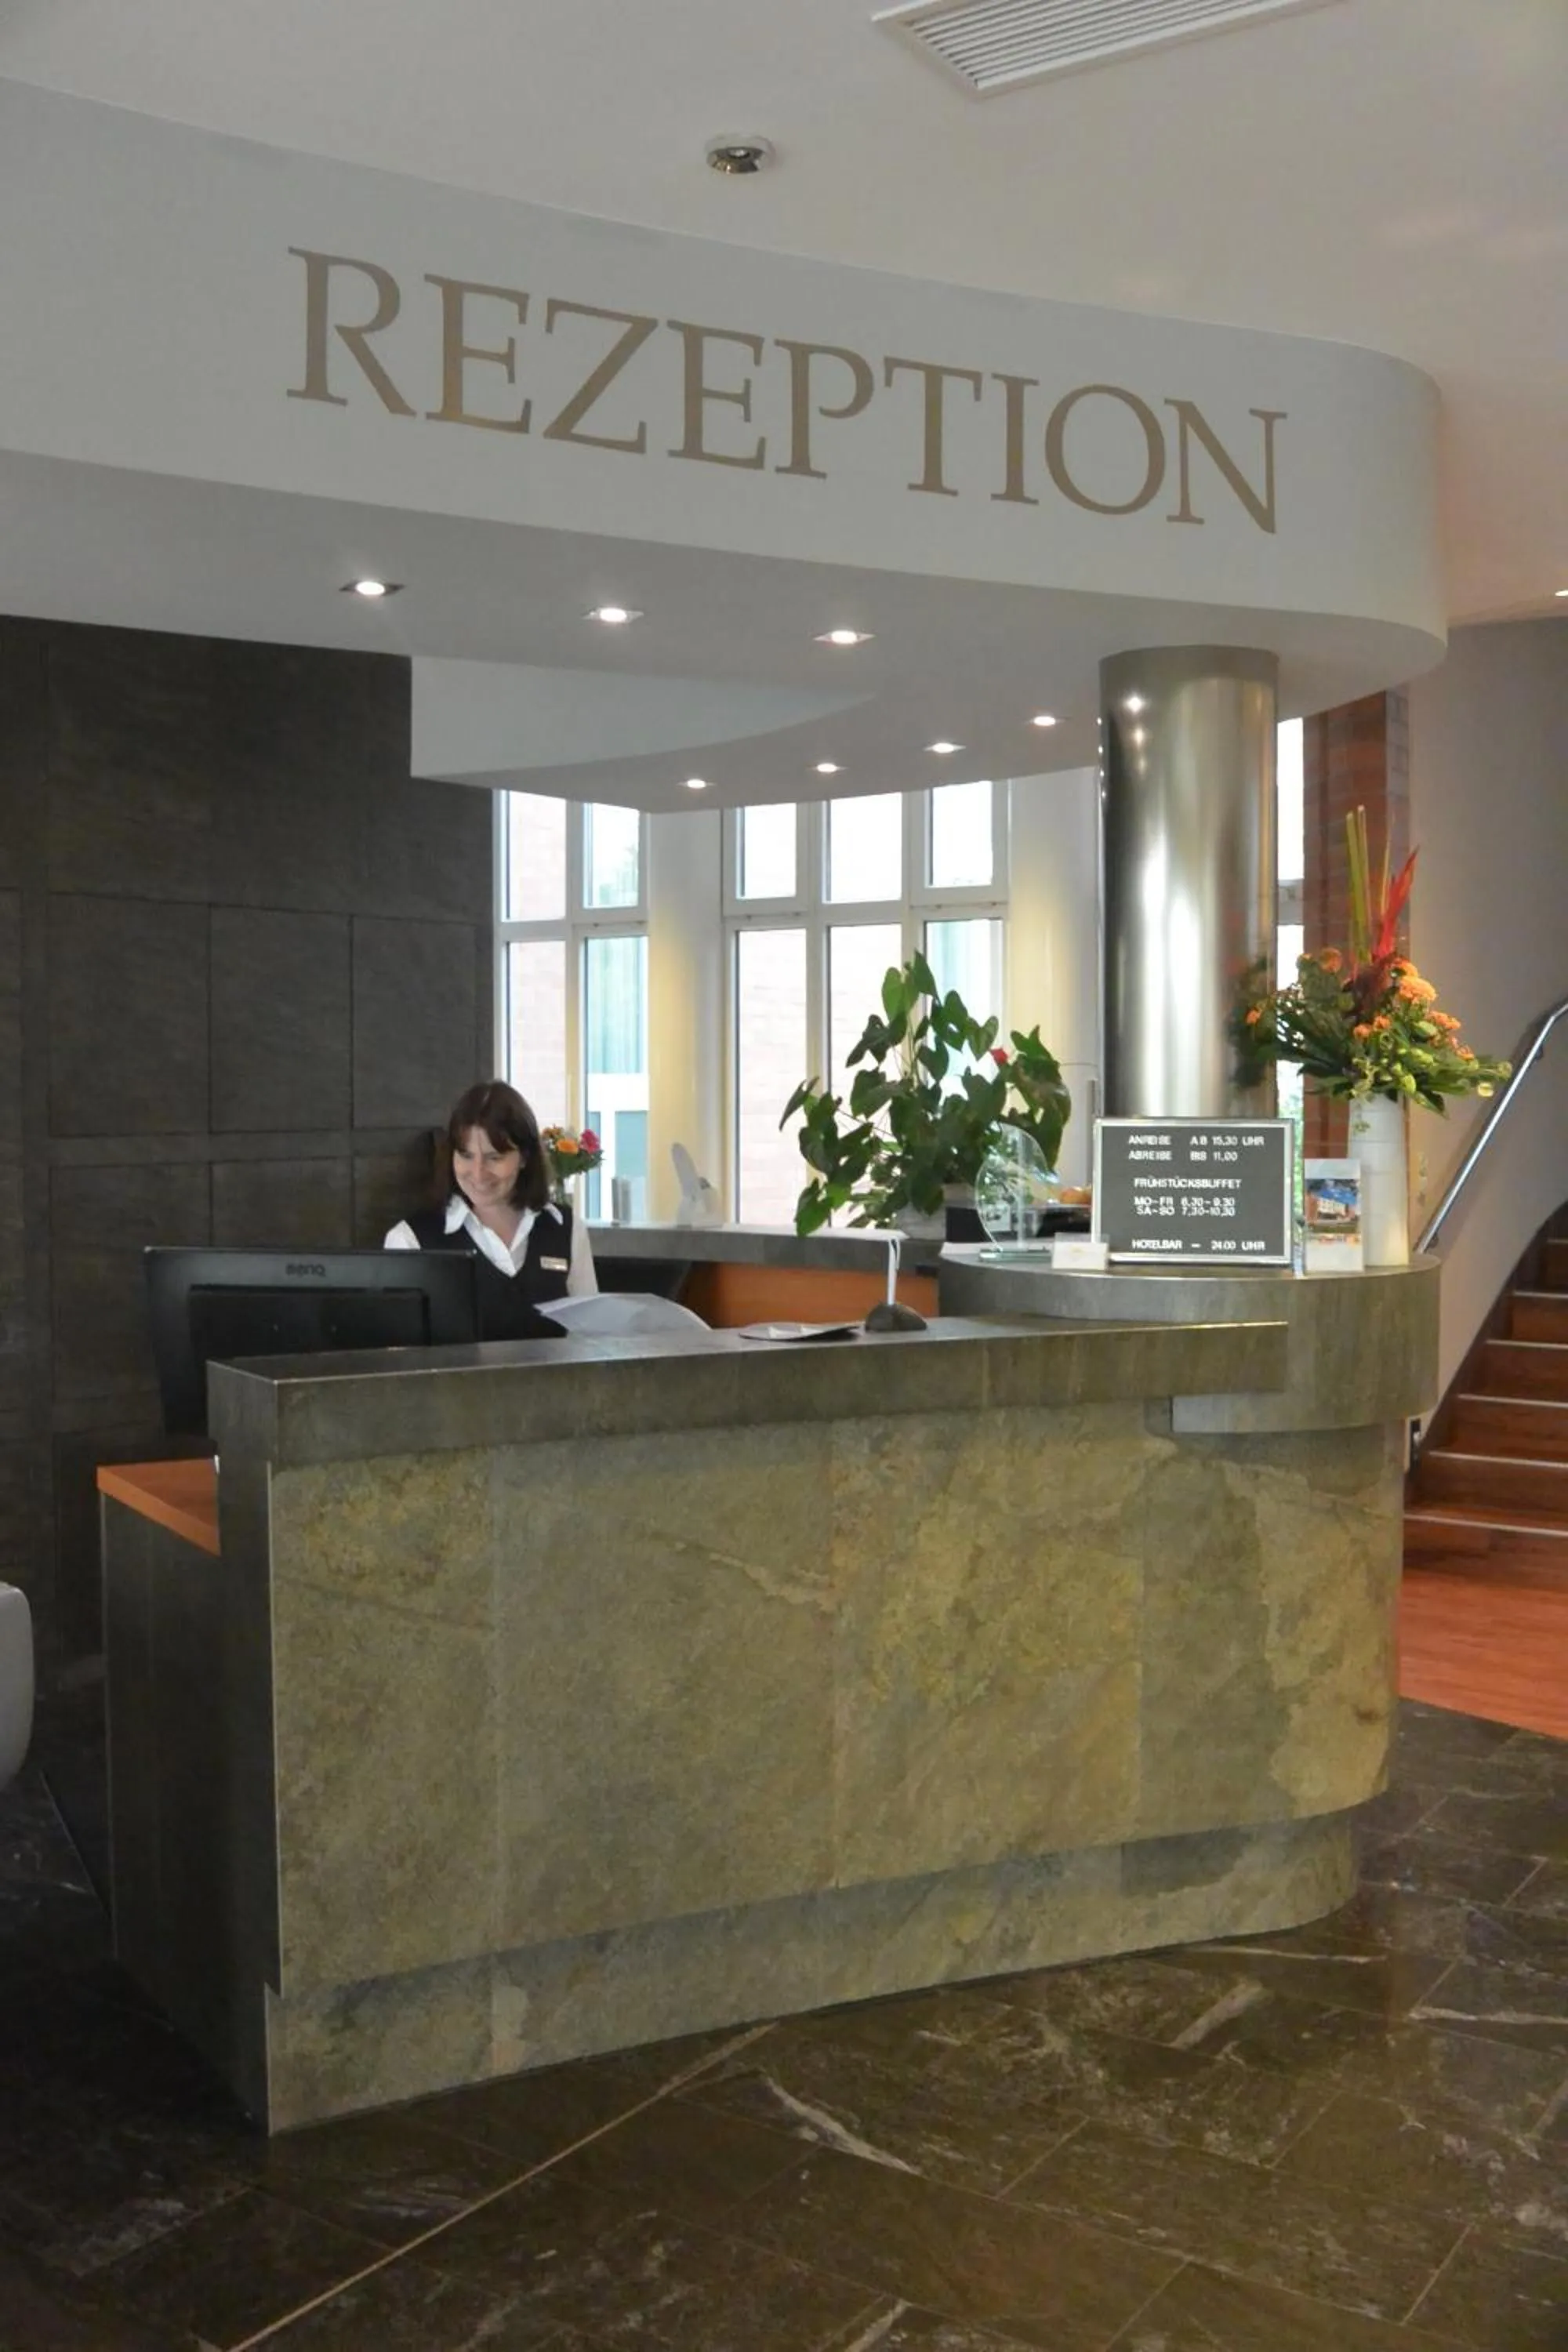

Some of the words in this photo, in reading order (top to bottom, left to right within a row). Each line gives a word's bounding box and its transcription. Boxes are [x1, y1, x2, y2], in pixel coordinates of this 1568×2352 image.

[286, 246, 1287, 535] REZEPTION
[1127, 1134, 1171, 1145] ANREISE
[1241, 1135, 1265, 1146] UHR
[1127, 1150, 1172, 1161] ABREISE
[1189, 1151, 1207, 1162] BIS
[1134, 1175, 1242, 1189] FRÜHSTÜCKSBUFFET
[1131, 1239, 1183, 1249] HOTELBAR
[1241, 1241, 1265, 1250] UHR
